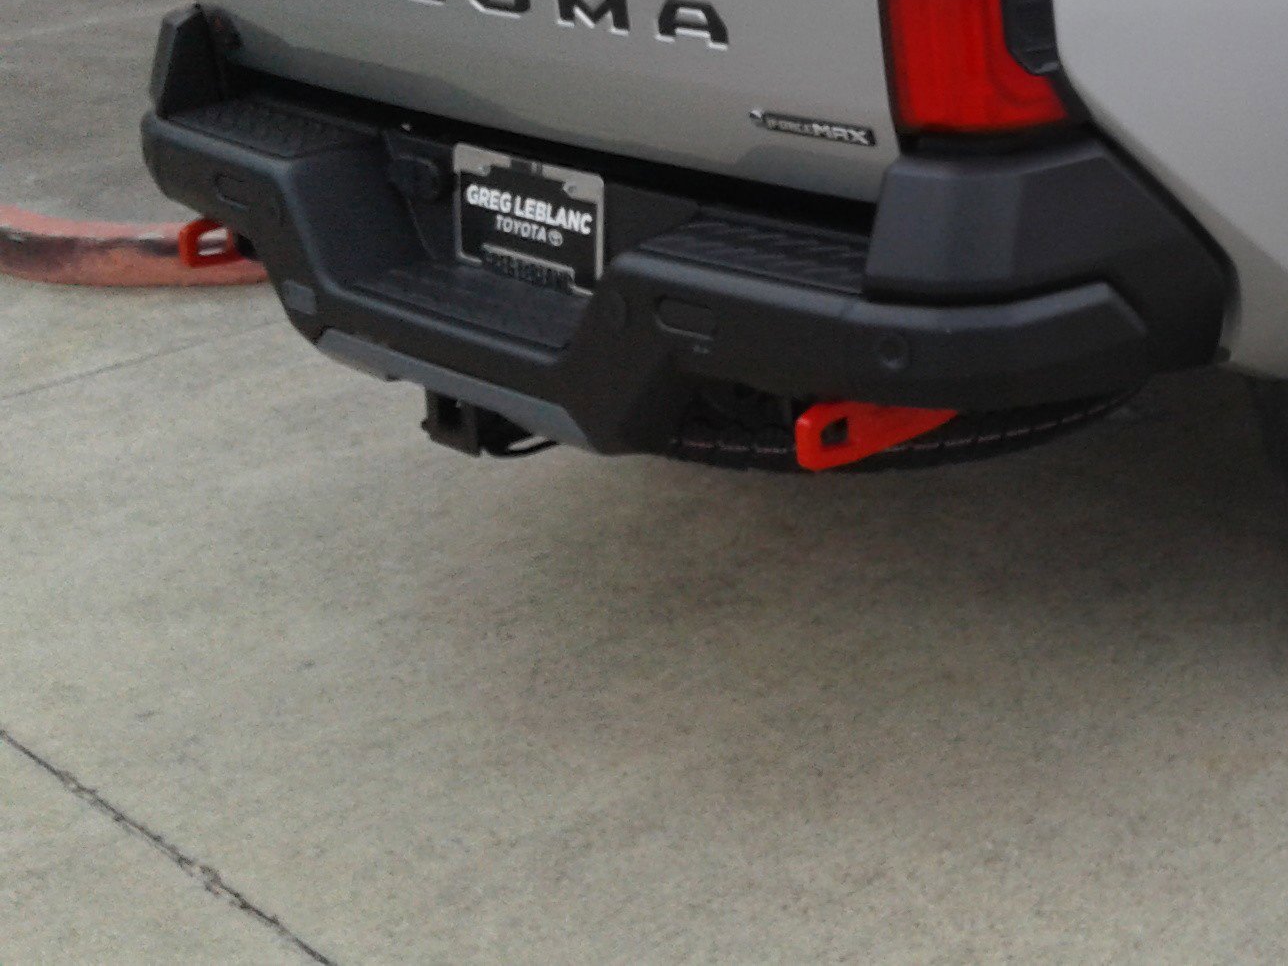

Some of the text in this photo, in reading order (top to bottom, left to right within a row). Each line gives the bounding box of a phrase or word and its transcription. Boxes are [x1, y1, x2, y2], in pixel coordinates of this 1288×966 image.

[466, 184, 593, 235] GREG LEBLANC
[496, 214, 547, 243] TOYOTA
